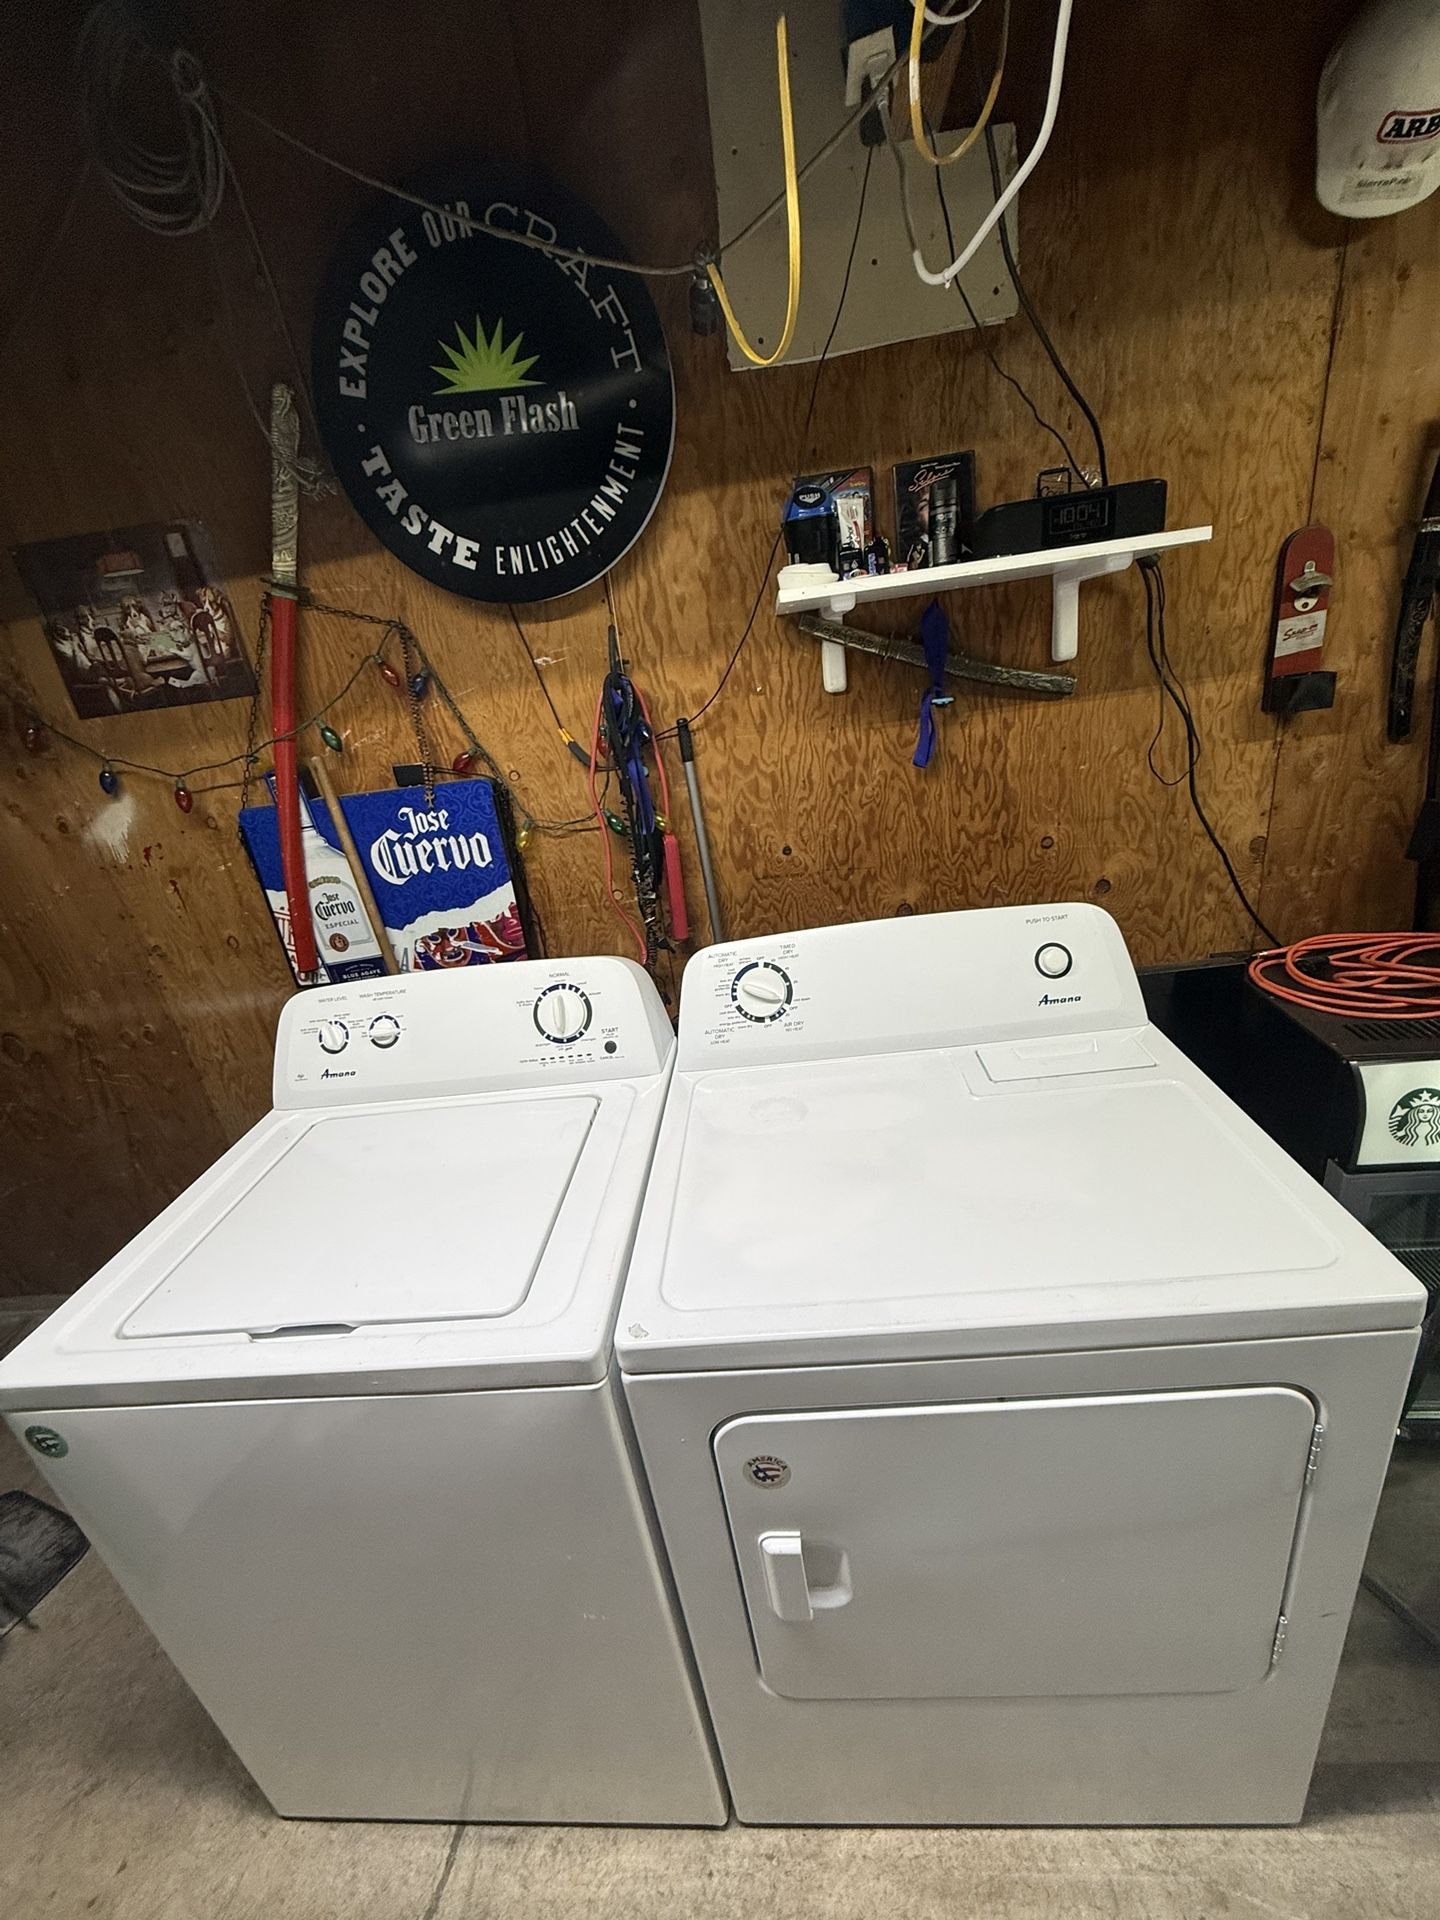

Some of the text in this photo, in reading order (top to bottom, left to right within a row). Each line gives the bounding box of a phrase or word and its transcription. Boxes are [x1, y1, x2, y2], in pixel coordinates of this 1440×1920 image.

[340, 201, 642, 398] EXPLORE OUR CRAFT
[408, 391, 579, 444] Green Flash
[361, 422, 644, 576] TASTE ENLIGHTENMENT
[398, 807, 449, 840] Jose
[371, 829, 492, 885] Cuervo
[315, 901, 355, 920] Cuervo
[322, 893, 339, 904] Jose
[325, 919, 359, 929] ESPECIAL
[1038, 994, 1081, 1006] Amana
[320, 1068, 356, 1081] Amana
